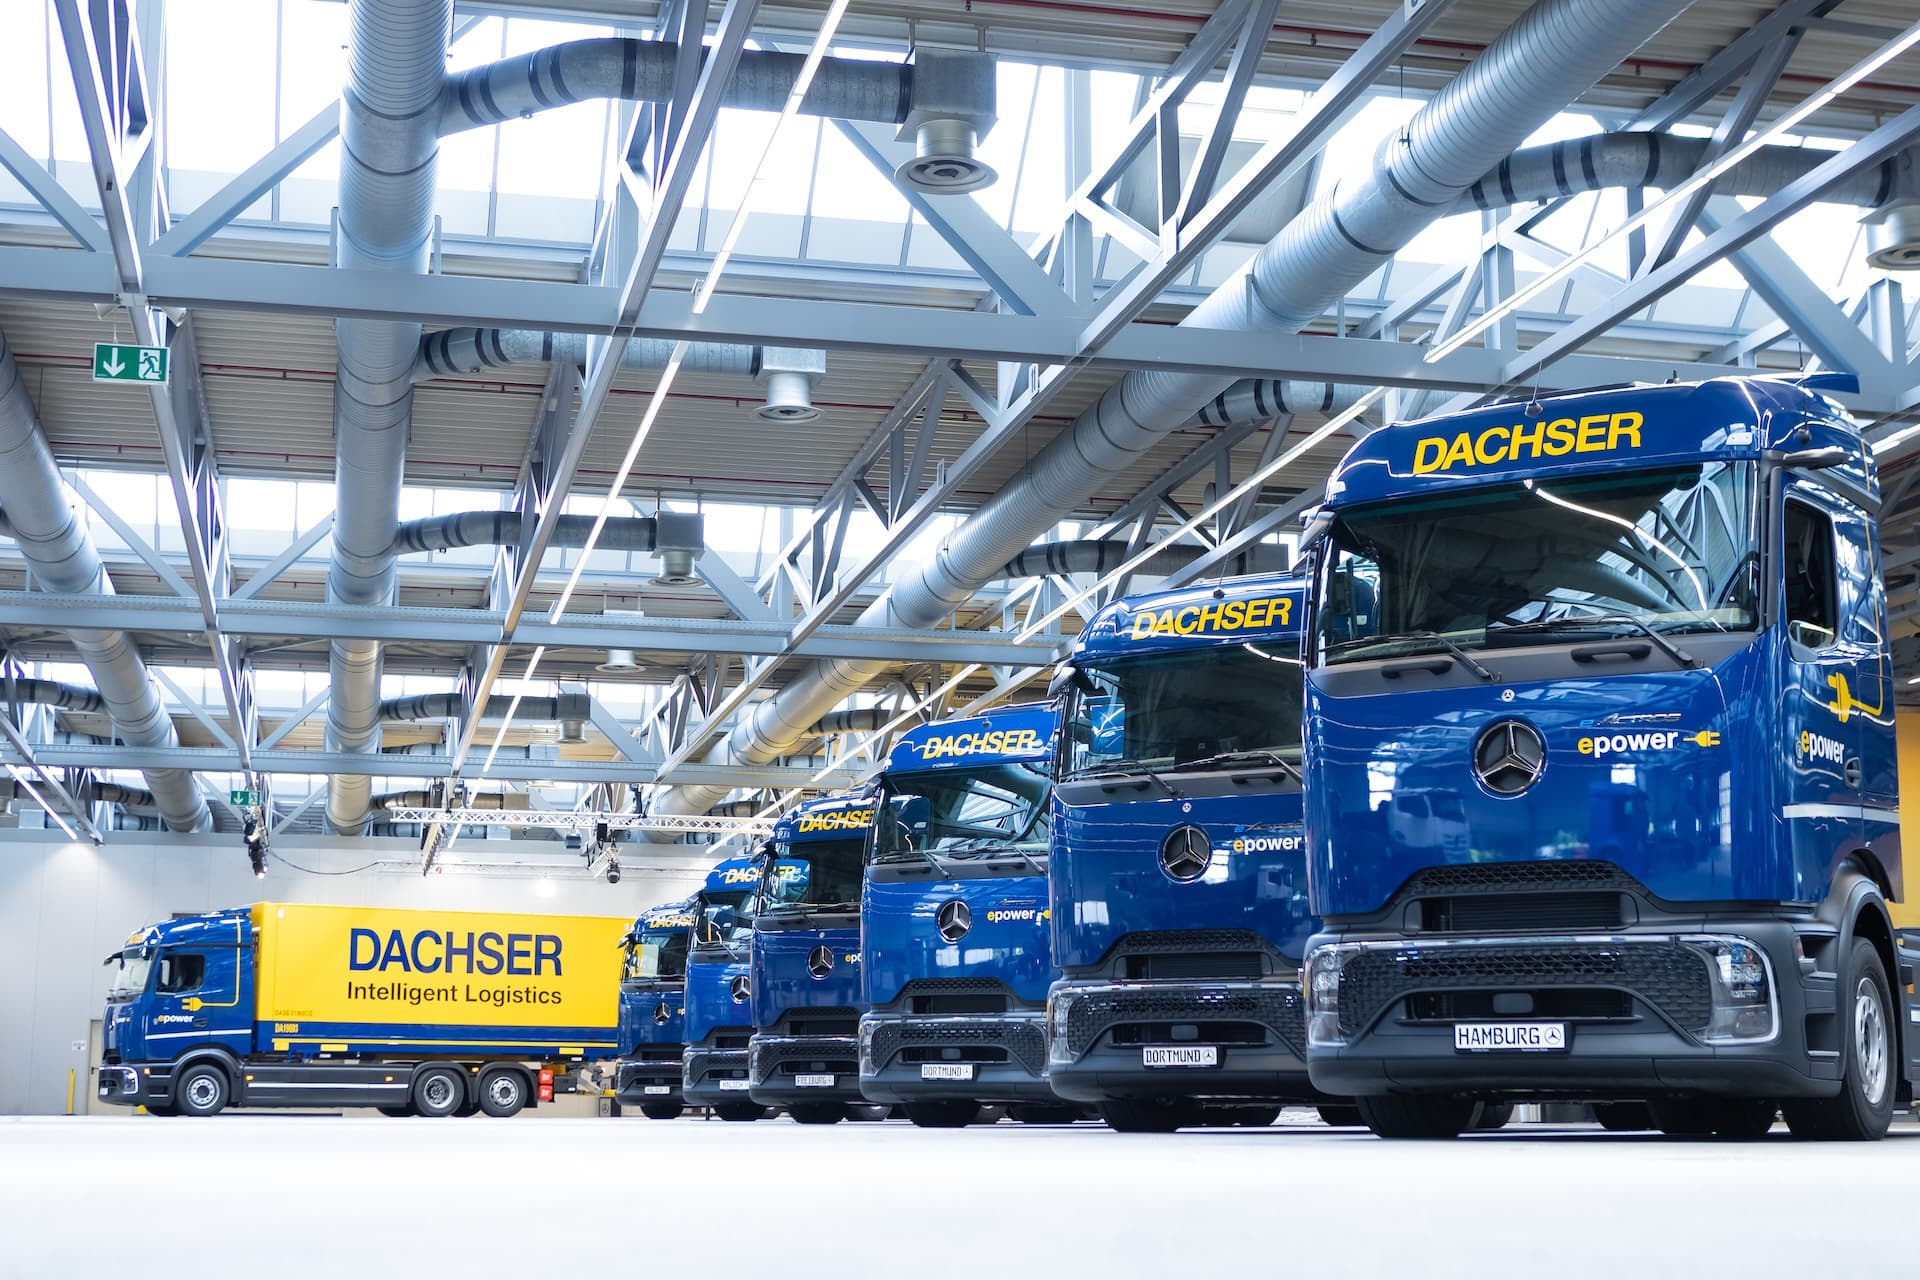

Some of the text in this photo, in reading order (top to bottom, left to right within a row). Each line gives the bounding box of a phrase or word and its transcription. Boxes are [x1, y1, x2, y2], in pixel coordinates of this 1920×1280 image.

[1412, 411, 1644, 475] DACHSER
[1131, 597, 1293, 641] DACHSER
[922, 729, 1037, 760] DACHSER
[1577, 731, 1679, 759] epower
[1801, 730, 1845, 765] epower
[1233, 836, 1302, 856] epower
[987, 909, 1036, 924] epower
[349, 928, 563, 976] DACHSER
[347, 981, 562, 1007] Intelligent Logistics
[158, 1014, 194, 1024] epower
[1458, 1027, 1540, 1045] HAMBURG
[1146, 1049, 1201, 1063] DORTMUND
[923, 1066, 962, 1077] DORTMUND
